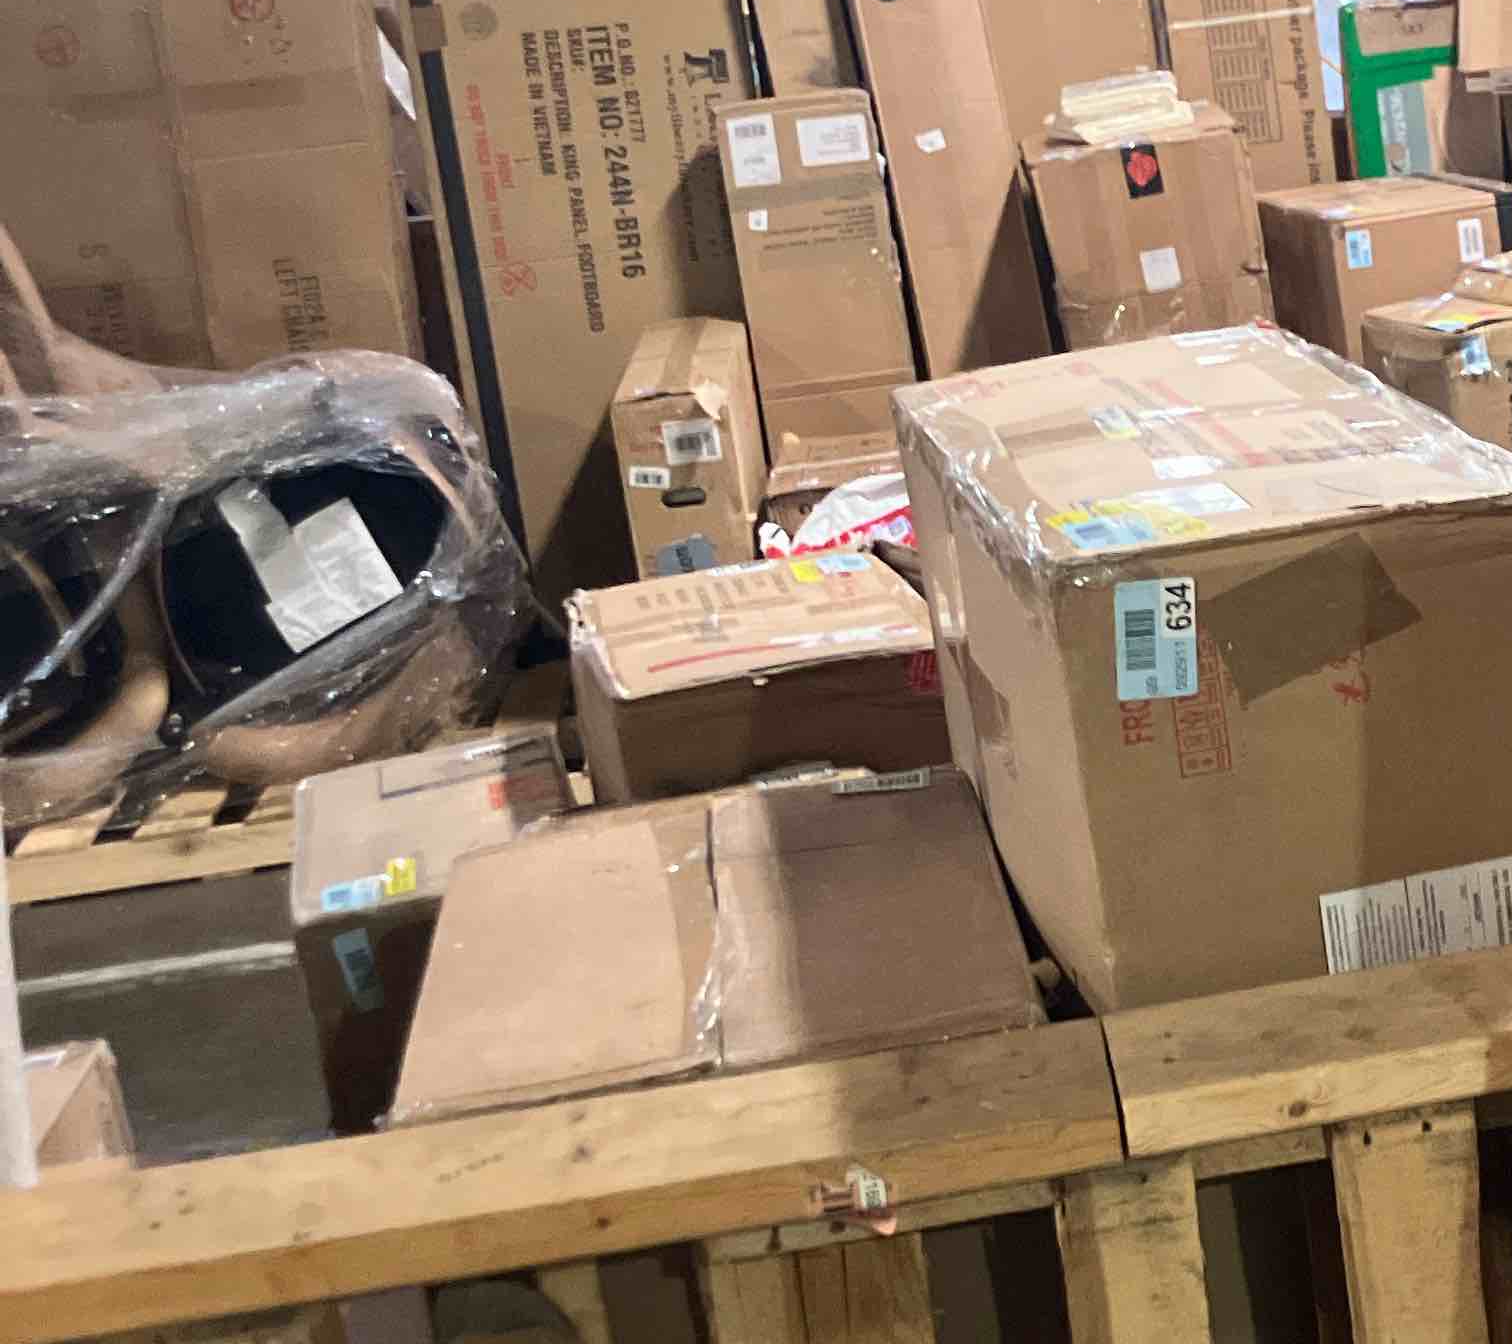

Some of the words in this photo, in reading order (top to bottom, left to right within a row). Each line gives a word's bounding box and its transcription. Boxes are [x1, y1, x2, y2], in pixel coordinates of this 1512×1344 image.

[521, 32, 543, 78] MADE
[586, 25, 618, 86] ITEM
[529, 83, 546, 100] IN
[531, 107, 557, 176] VIETNAM
[596, 96, 625, 139] NO:
[567, 187, 589, 238] PANEL
[603, 146, 647, 278] 244N-BR16
[575, 243, 605, 333] FOOTBOARD
[1164, 583, 1192, 631] 634
